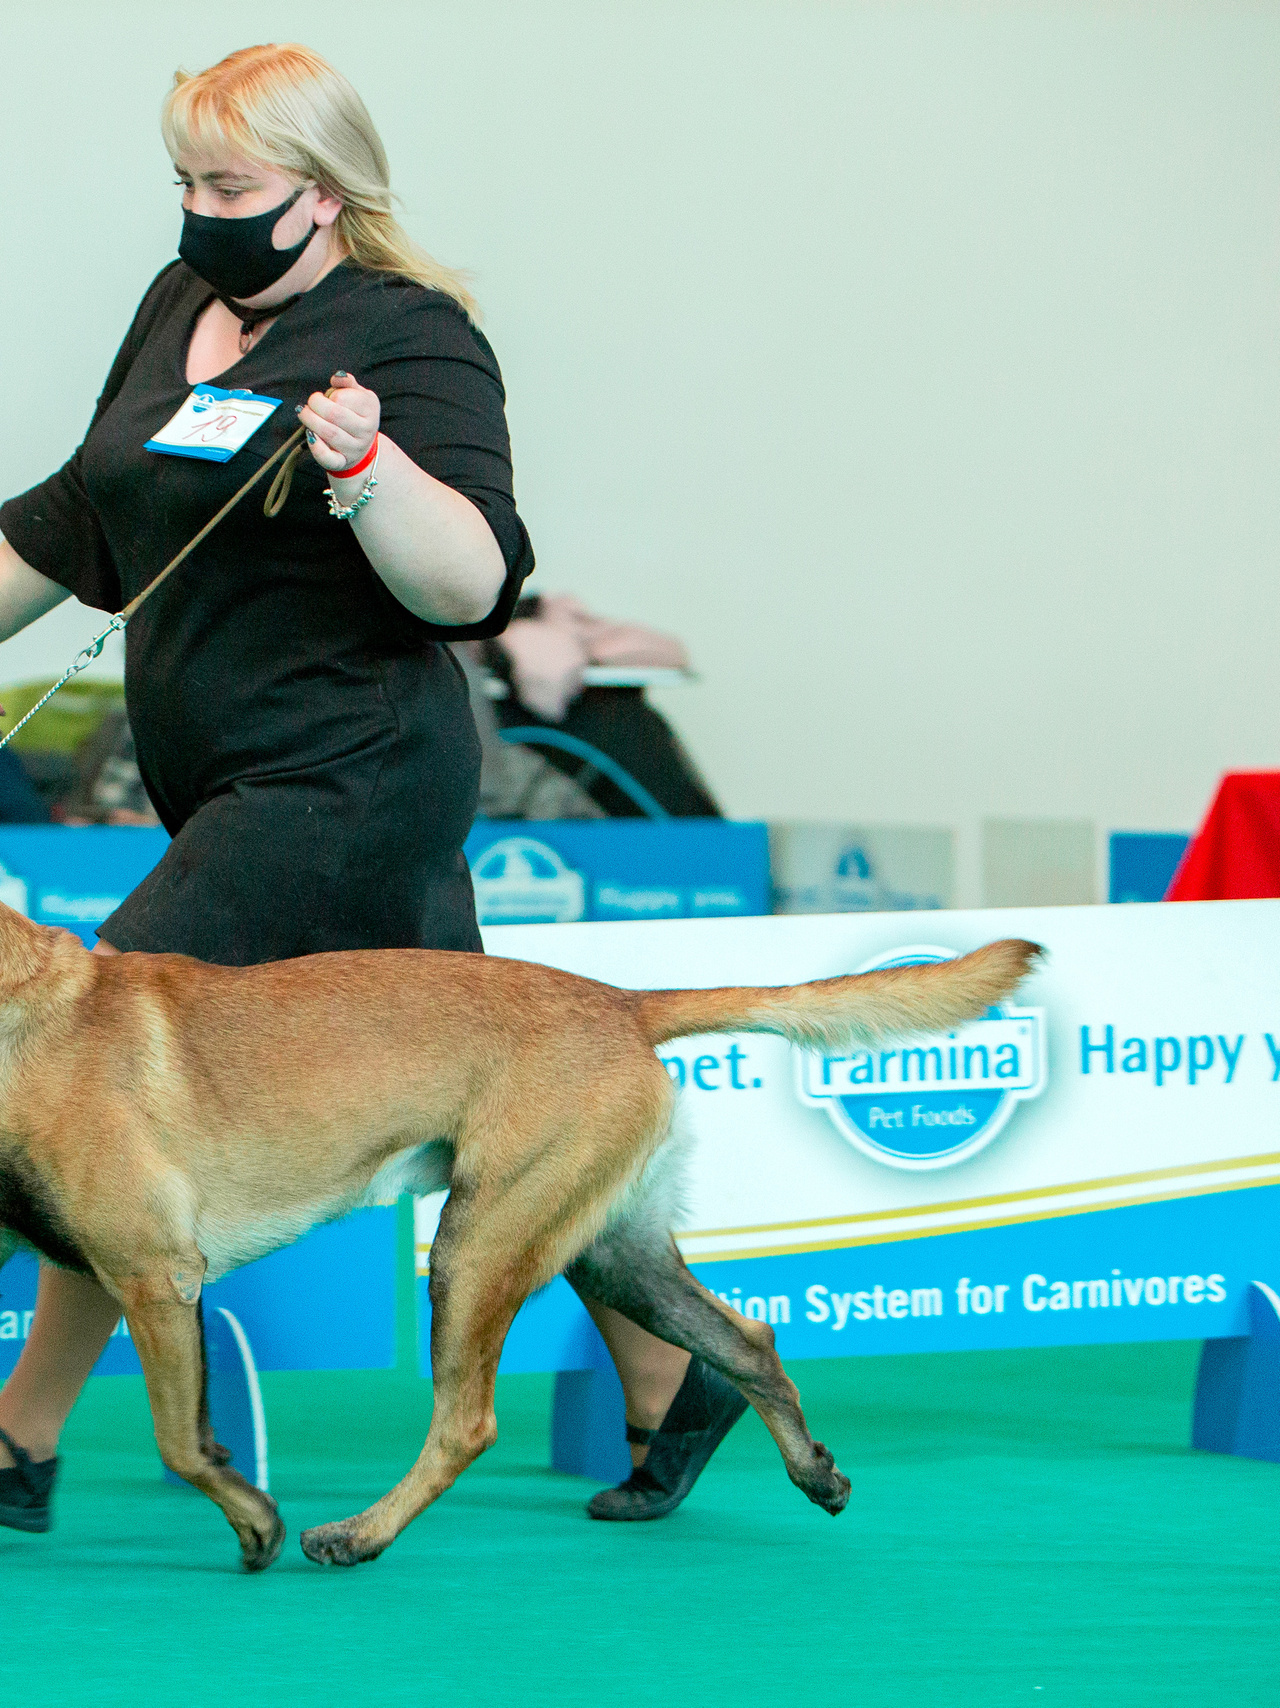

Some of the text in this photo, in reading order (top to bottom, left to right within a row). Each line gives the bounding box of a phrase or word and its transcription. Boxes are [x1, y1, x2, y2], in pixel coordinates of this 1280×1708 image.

[1081, 1024, 1244, 1086] Happy
[869, 1104, 976, 1129] Pet Foods
[805, 1284, 942, 1331] System
[956, 1277, 1010, 1315] for
[1022, 1268, 1227, 1312] Carnivores
